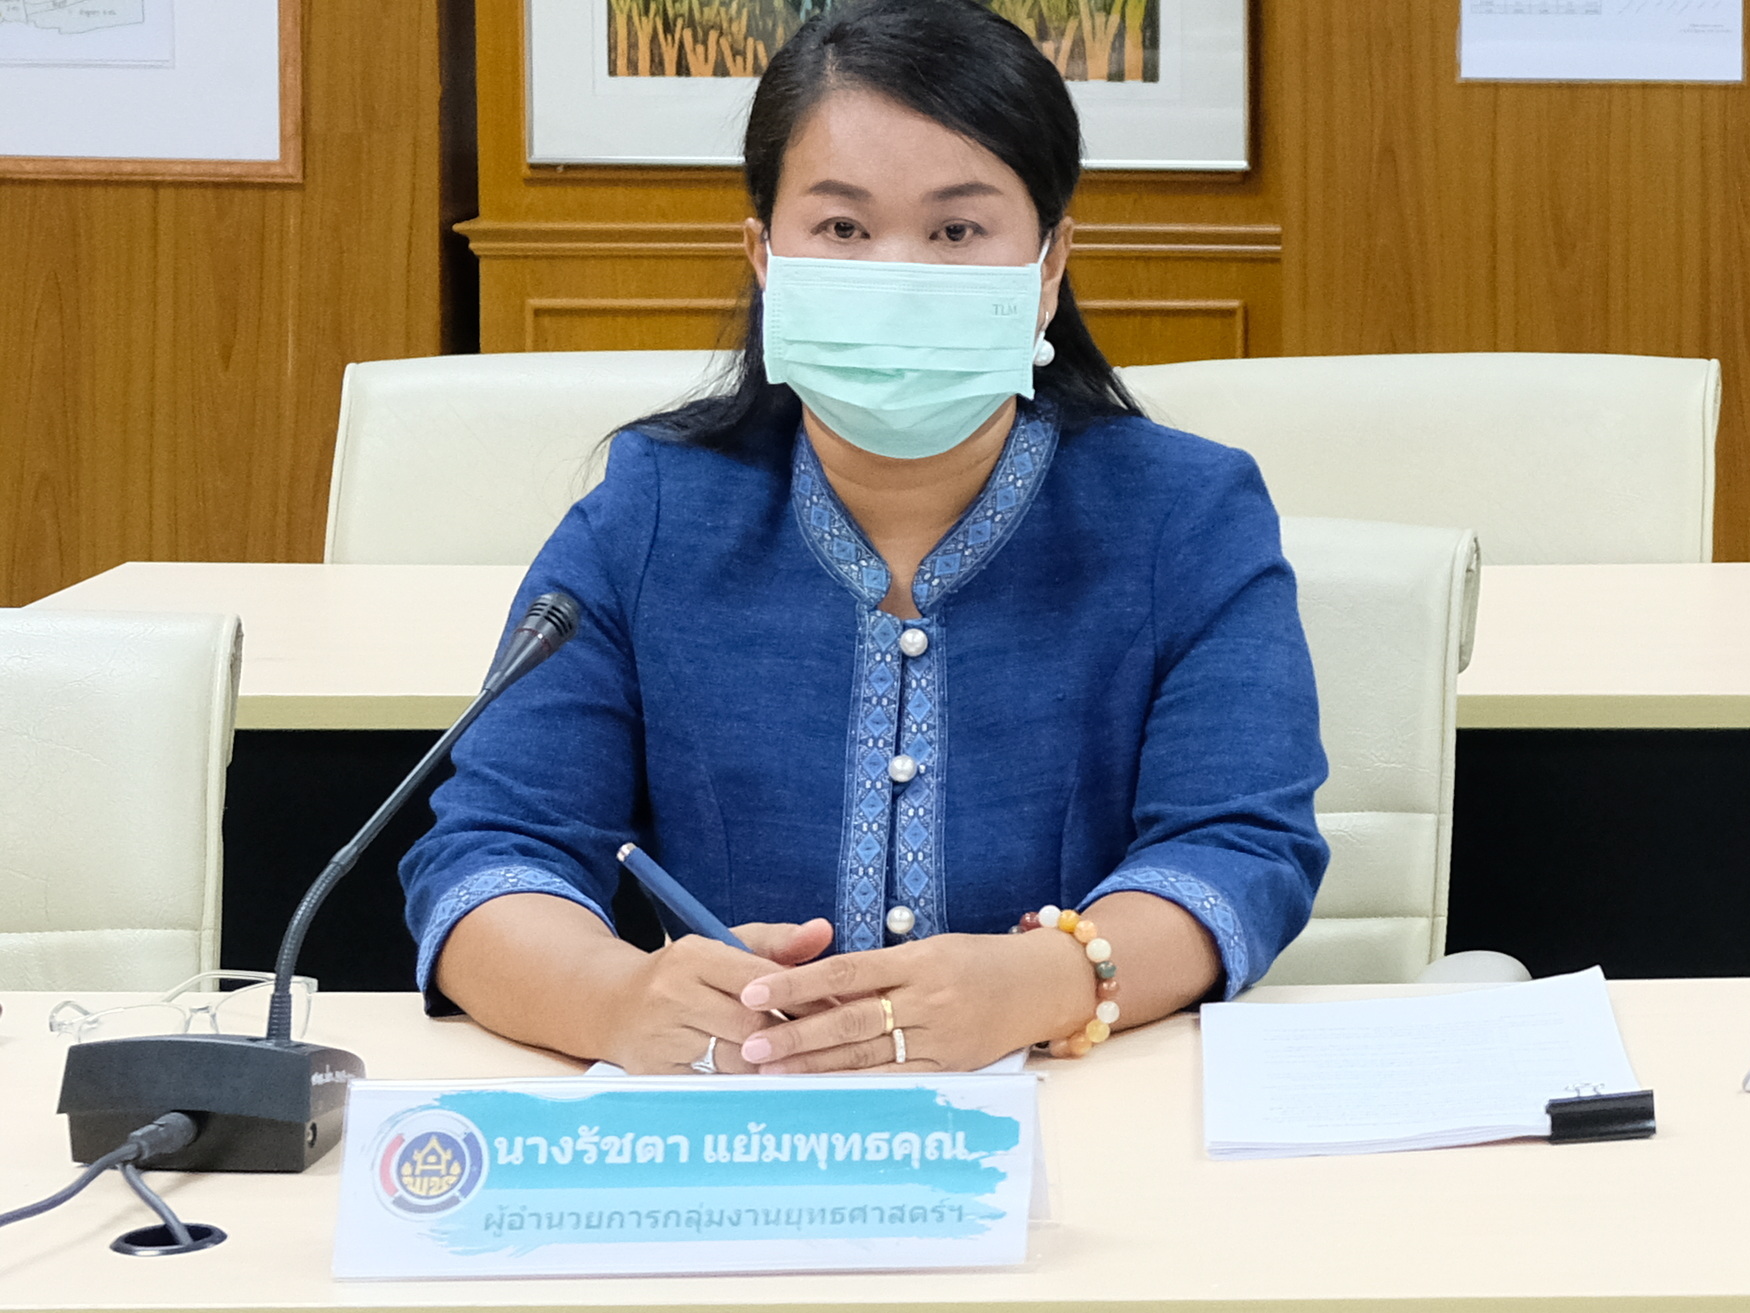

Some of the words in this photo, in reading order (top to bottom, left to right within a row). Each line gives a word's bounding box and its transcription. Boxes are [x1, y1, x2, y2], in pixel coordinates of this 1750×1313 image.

[494, 1125, 689, 1166] นางรัชดา
[703, 1122, 968, 1170] แย้มพุทธคุณ
[484, 1197, 963, 1238] ผู้อำนวยการกลุ่มงานยุทธศาสตร์ฯ
